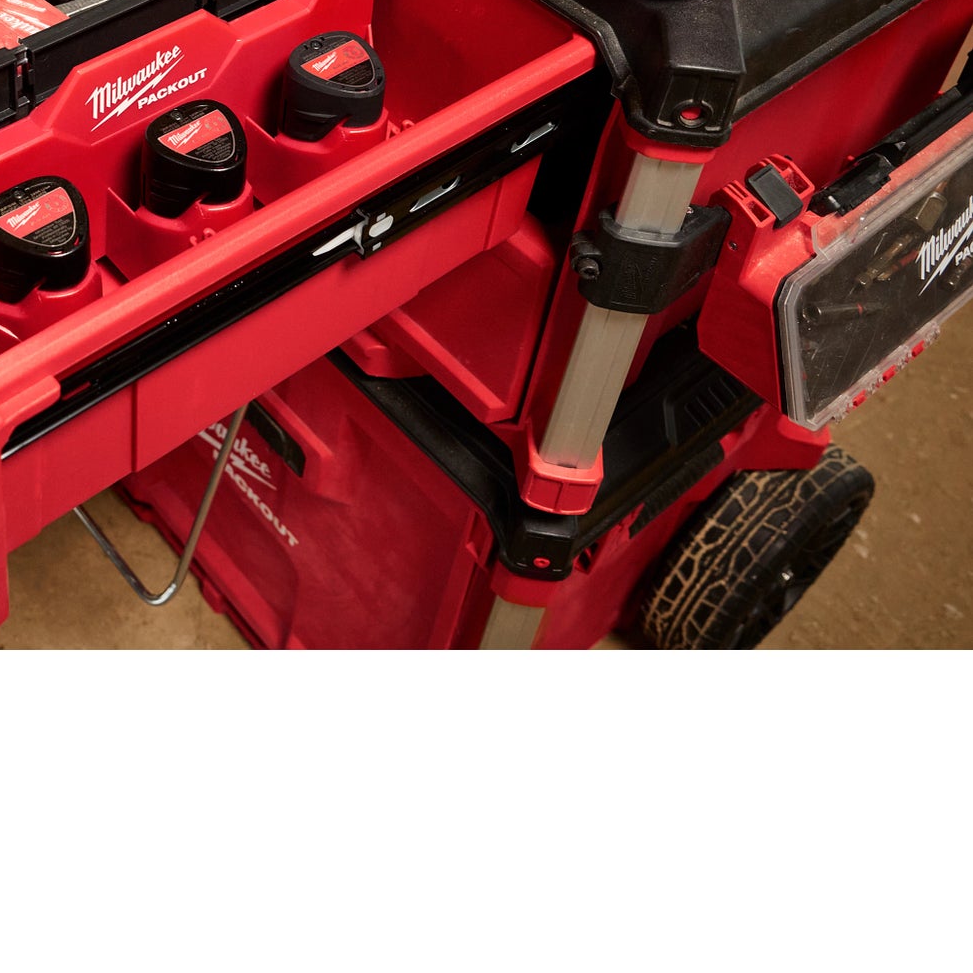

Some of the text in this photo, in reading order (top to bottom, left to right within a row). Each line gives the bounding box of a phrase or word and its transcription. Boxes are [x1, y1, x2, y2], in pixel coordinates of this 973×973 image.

[85, 45, 182, 120] Milwaukee
[137, 68, 208, 110] PACKOUT
[167, 120, 202, 146] Milwaukee
[6, 201, 41, 228] Milwaukee
